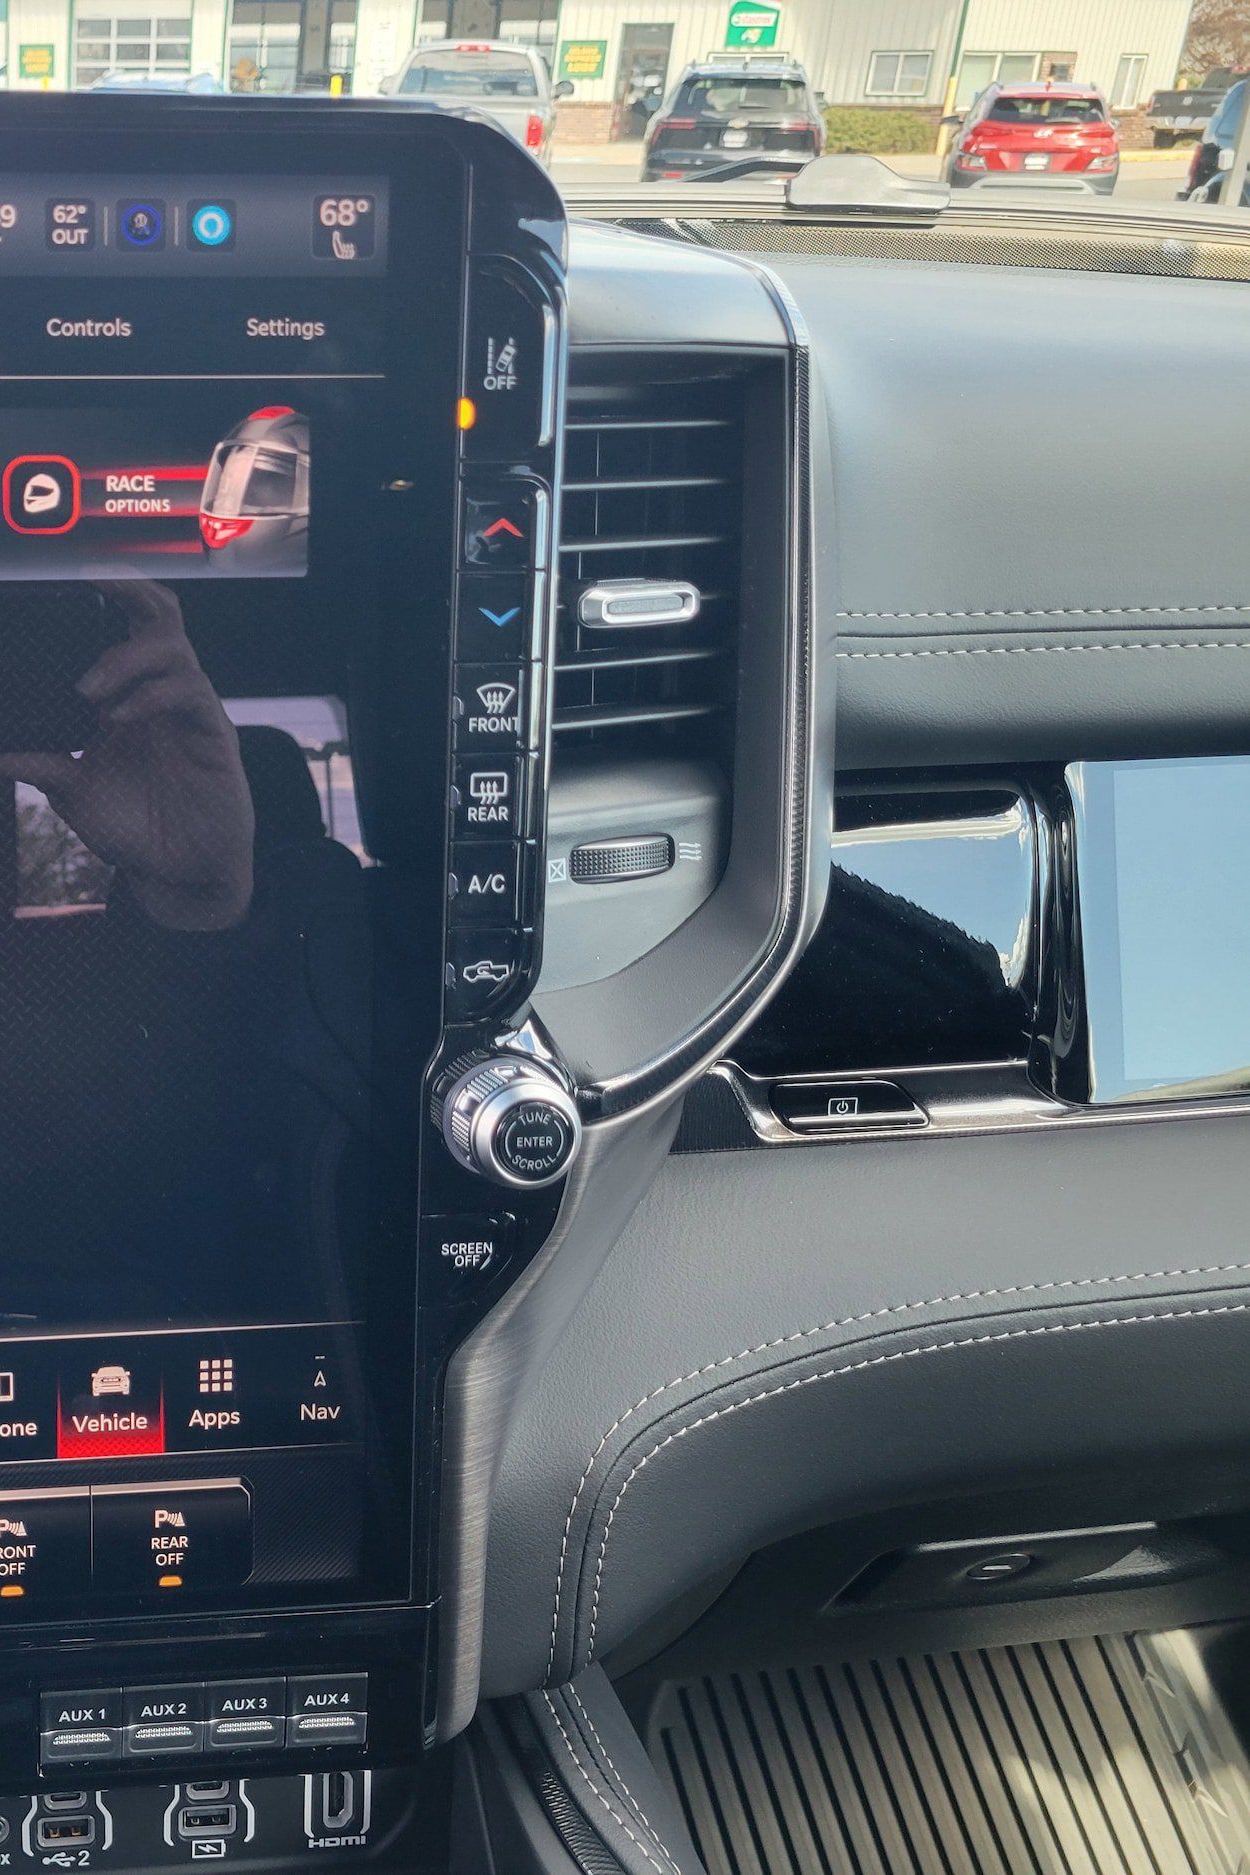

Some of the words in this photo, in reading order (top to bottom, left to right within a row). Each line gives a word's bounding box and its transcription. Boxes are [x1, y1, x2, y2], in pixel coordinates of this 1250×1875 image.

[52, 229, 88, 245] OUT
[46, 318, 132, 337] Controls
[246, 317, 325, 340] Settings
[483, 376, 517, 390] OFF
[105, 475, 155, 492] RACE
[105, 499, 171, 513] OPTIONS
[468, 716, 519, 733] FRONT
[468, 806, 509, 822] REAR
[468, 875, 505, 893] A/C
[518, 1111, 552, 1126] TUNE
[516, 1136, 553, 1148] ENTER
[511, 1154, 557, 1170] SCROLL
[441, 1242, 493, 1256] SCREEN
[454, 1255, 481, 1267] OFF
[188, 1409, 241, 1428] Apps
[300, 1404, 341, 1422] Nav
[72, 1412, 148, 1433] Vehicle
[151, 1536, 188, 1549] REAR
[155, 1552, 184, 1566] OFF
[222, 1699, 256, 1712] AUX
[258, 1697, 268, 1709] 3
[304, 1693, 338, 1707] AUX
[340, 1693, 350, 1705] 4
[58, 1709, 94, 1722] AUX
[98, 1708, 106, 1720] 1
[141, 1704, 175, 1717] AUX
[177, 1703, 187, 1715] 2
[308, 1834, 367, 1849] HDMI
[78, 1851, 90, 1867] 2
